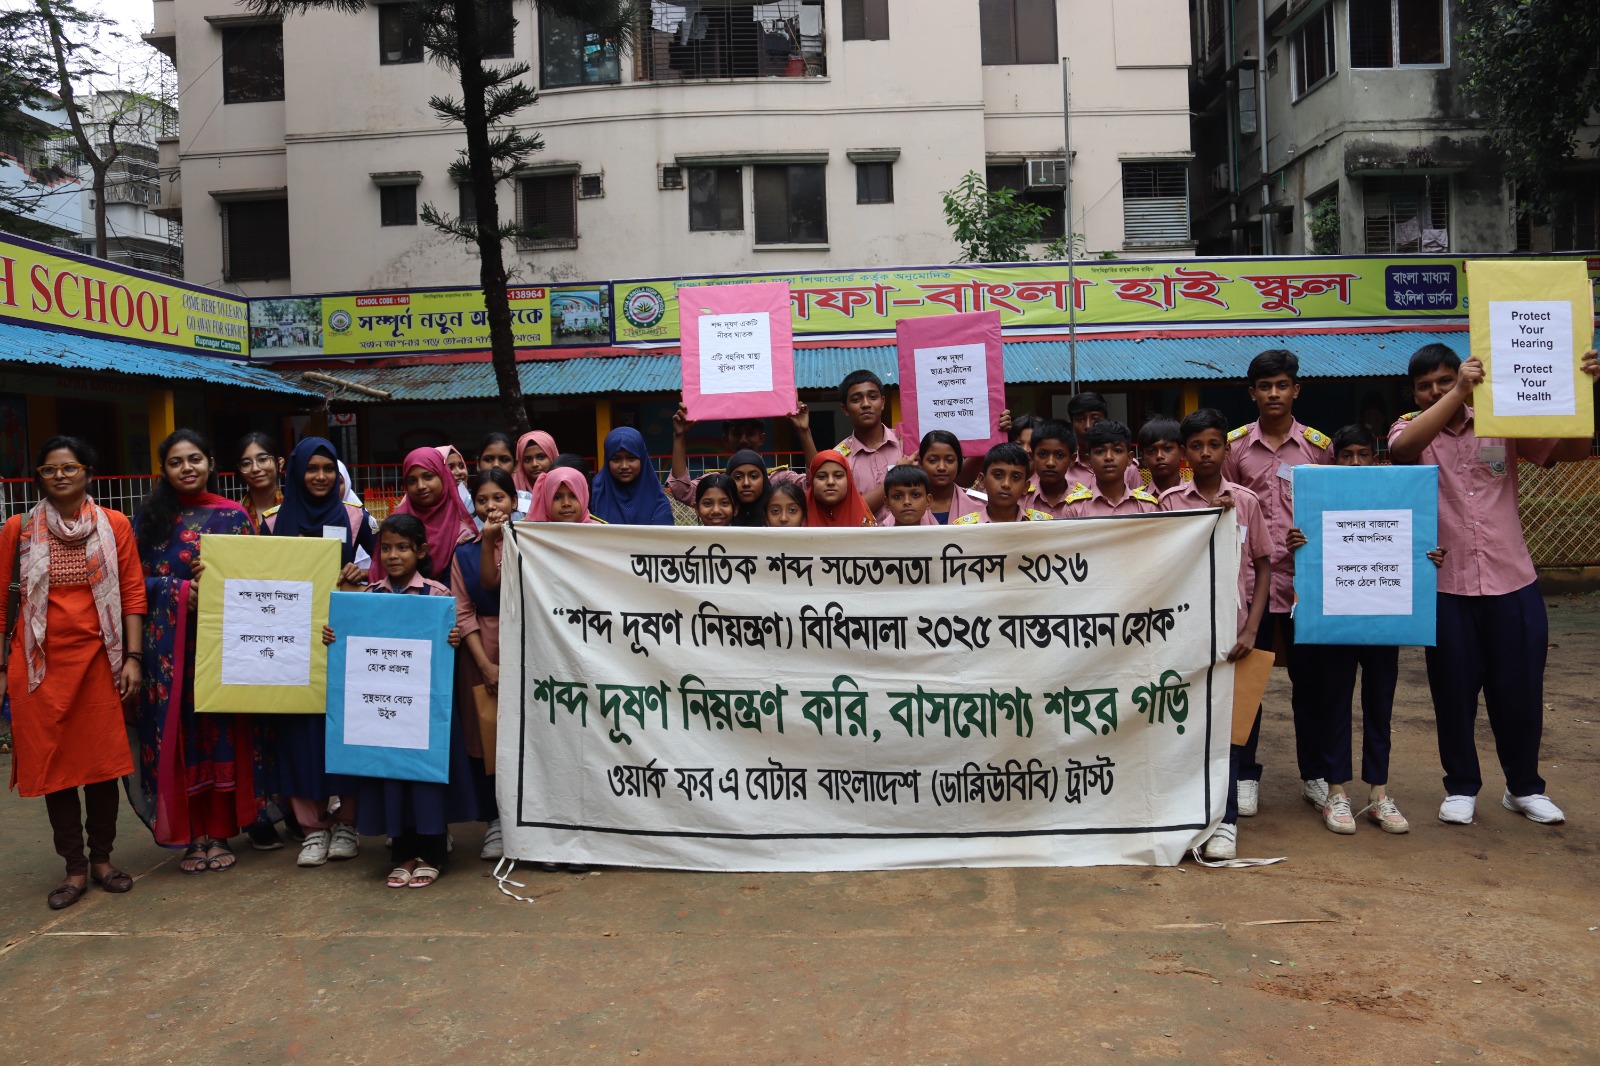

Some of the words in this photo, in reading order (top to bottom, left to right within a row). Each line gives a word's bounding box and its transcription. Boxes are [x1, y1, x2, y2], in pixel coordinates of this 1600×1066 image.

[893, 270, 952, 282] অনুমোদিত
[1391, 271, 1419, 286] বাংলা
[1421, 271, 1451, 285] মাধ্যম
[1105, 266, 1234, 312] হাই
[1235, 273, 1362, 317] স্কুল
[1393, 289, 1425, 306] ইংলিশ
[1426, 289, 1453, 305] ভার্সন
[30, 264, 179, 337] SCHOOL
[357, 297, 378, 306] SCHOOL
[379, 296, 393, 305] CODE
[356, 306, 414, 338] সম্পূর্ণ
[418, 311, 464, 335] নতুন
[1511, 311, 1551, 321] Protect
[1518, 324, 1545, 334] Your
[195, 335, 220, 349] Rupnagar
[221, 340, 241, 351] Campus
[1511, 338, 1554, 350] Hearing
[1513, 364, 1553, 374] Protect
[1521, 377, 1547, 387] Your
[1516, 391, 1552, 401] Health
[1335, 520, 1366, 529] আপনার
[1368, 520, 1399, 529] বাজানো
[1342, 532, 1355, 544] হর্ন
[1356, 532, 1393, 544] আপনিসহ
[630, 543, 757, 585] আন্তর্জাতিক
[765, 552, 813, 586] শব্দ
[820, 555, 932, 586] সচেতনতা
[940, 543, 1007, 586] দিবস
[1017, 552, 1089, 586] ২০২৬
[1336, 564, 1368, 573] সকলকে
[1370, 561, 1399, 573] বধিরতা
[1335, 576, 1355, 587] দিকে
[1357, 575, 1376, 587] ঠেলে
[1379, 576, 1402, 588] দিচ্ছে
[238, 591, 252, 600] শব্দ
[254, 591, 272, 602] দূষণ
[261, 604, 276, 615] করি
[552, 605, 612, 644] “শব্দ
[620, 608, 683, 657] দূষণ
[691, 601, 793, 650] (নিয়ন্ত্রণ)
[800, 601, 908, 650] বিধিমালা
[916, 614, 992, 650] ২০২৫
[998, 611, 1120, 650] বাস্তবায়ন
[239, 634, 275, 643] বাসযোগ্য
[277, 635, 295, 644] শহর
[365, 648, 378, 657] শব্দ
[381, 649, 398, 660] দূষণ
[400, 650, 413, 659] বন্ধ
[367, 663, 386, 672] হোক
[388, 664, 410, 674] প্রজন্ম
[393, 695, 413, 706] বেড়ে
[533, 675, 588, 727] শব্দ
[595, 679, 671, 745] দূষণ
[678, 673, 788, 734] নিয়ন্ত্রণ
[886, 683, 1033, 738] বাসযোগ্য
[1043, 685, 1119, 736] শহর
[1131, 669, 1191, 735] গড়ি
[607, 758, 668, 798] ওয়ার্ক
[674, 767, 714, 802] ফর
[719, 767, 739, 800] এ
[746, 756, 807, 801] বেটার
[817, 768, 921, 804] বাংলাদেশ
[1065, 755, 1116, 804] ট্রাস্ট
